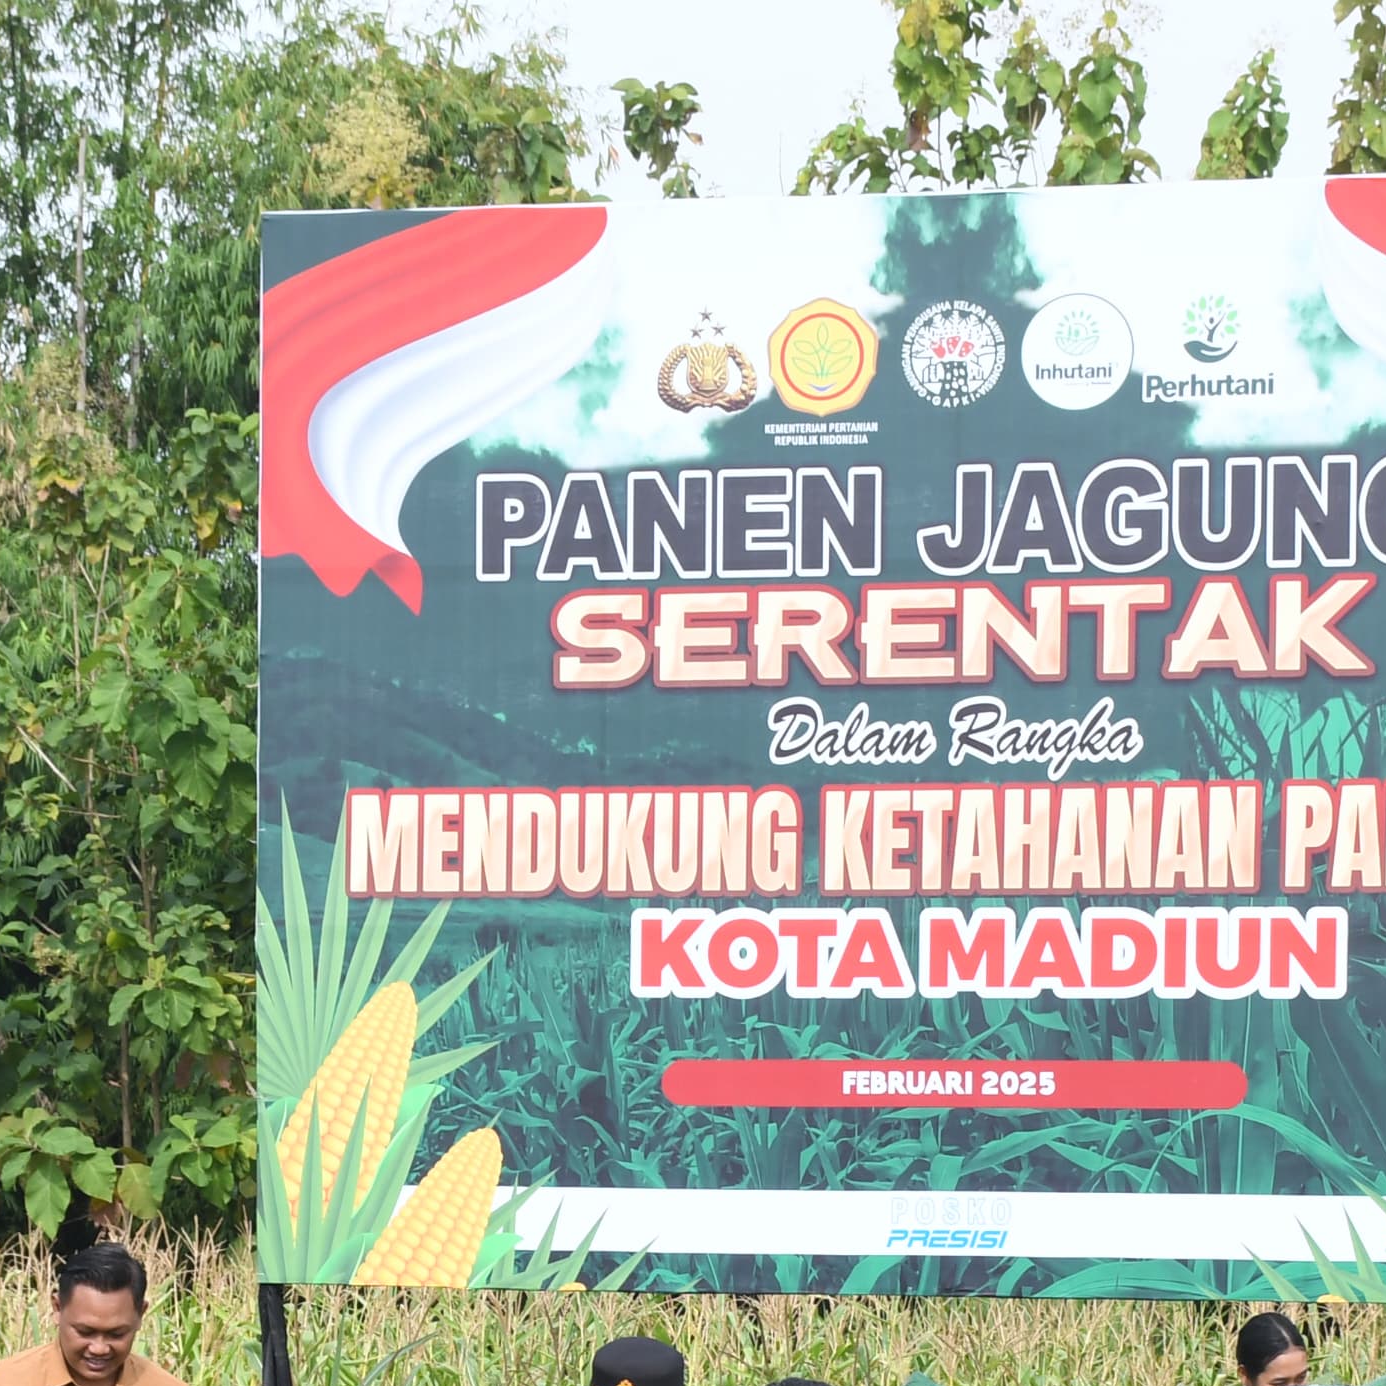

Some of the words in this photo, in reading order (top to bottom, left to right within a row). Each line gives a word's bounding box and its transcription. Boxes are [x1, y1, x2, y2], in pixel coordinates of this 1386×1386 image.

[953, 299, 987, 320] KELAPA
[1035, 362, 1112, 380] Inhutani
[1144, 371, 1274, 399] Perhutani
[932, 392, 977, 408] GAPKI
[764, 423, 827, 434] KEMENTERIAN
[829, 421, 878, 433] PERTANIAN
[774, 435, 818, 446] REPUBLIK
[820, 434, 868, 445] INDONESIA
[476, 466, 883, 582] PANEN
[551, 573, 1377, 688] SERENTAK
[768, 697, 937, 765] Dalam
[948, 695, 1143, 781] Rangka
[345, 785, 803, 897] MENDUKUNG
[820, 779, 1262, 897] KETAHANAN
[631, 907, 912, 1000] KOTA
[919, 906, 1348, 999] MADIUN
[842, 1070, 973, 1095] FEBRUARI
[981, 1071, 1056, 1095] 2025
[890, 1196, 1013, 1226] POSKO
[886, 1229, 1008, 1249] PRESISI
